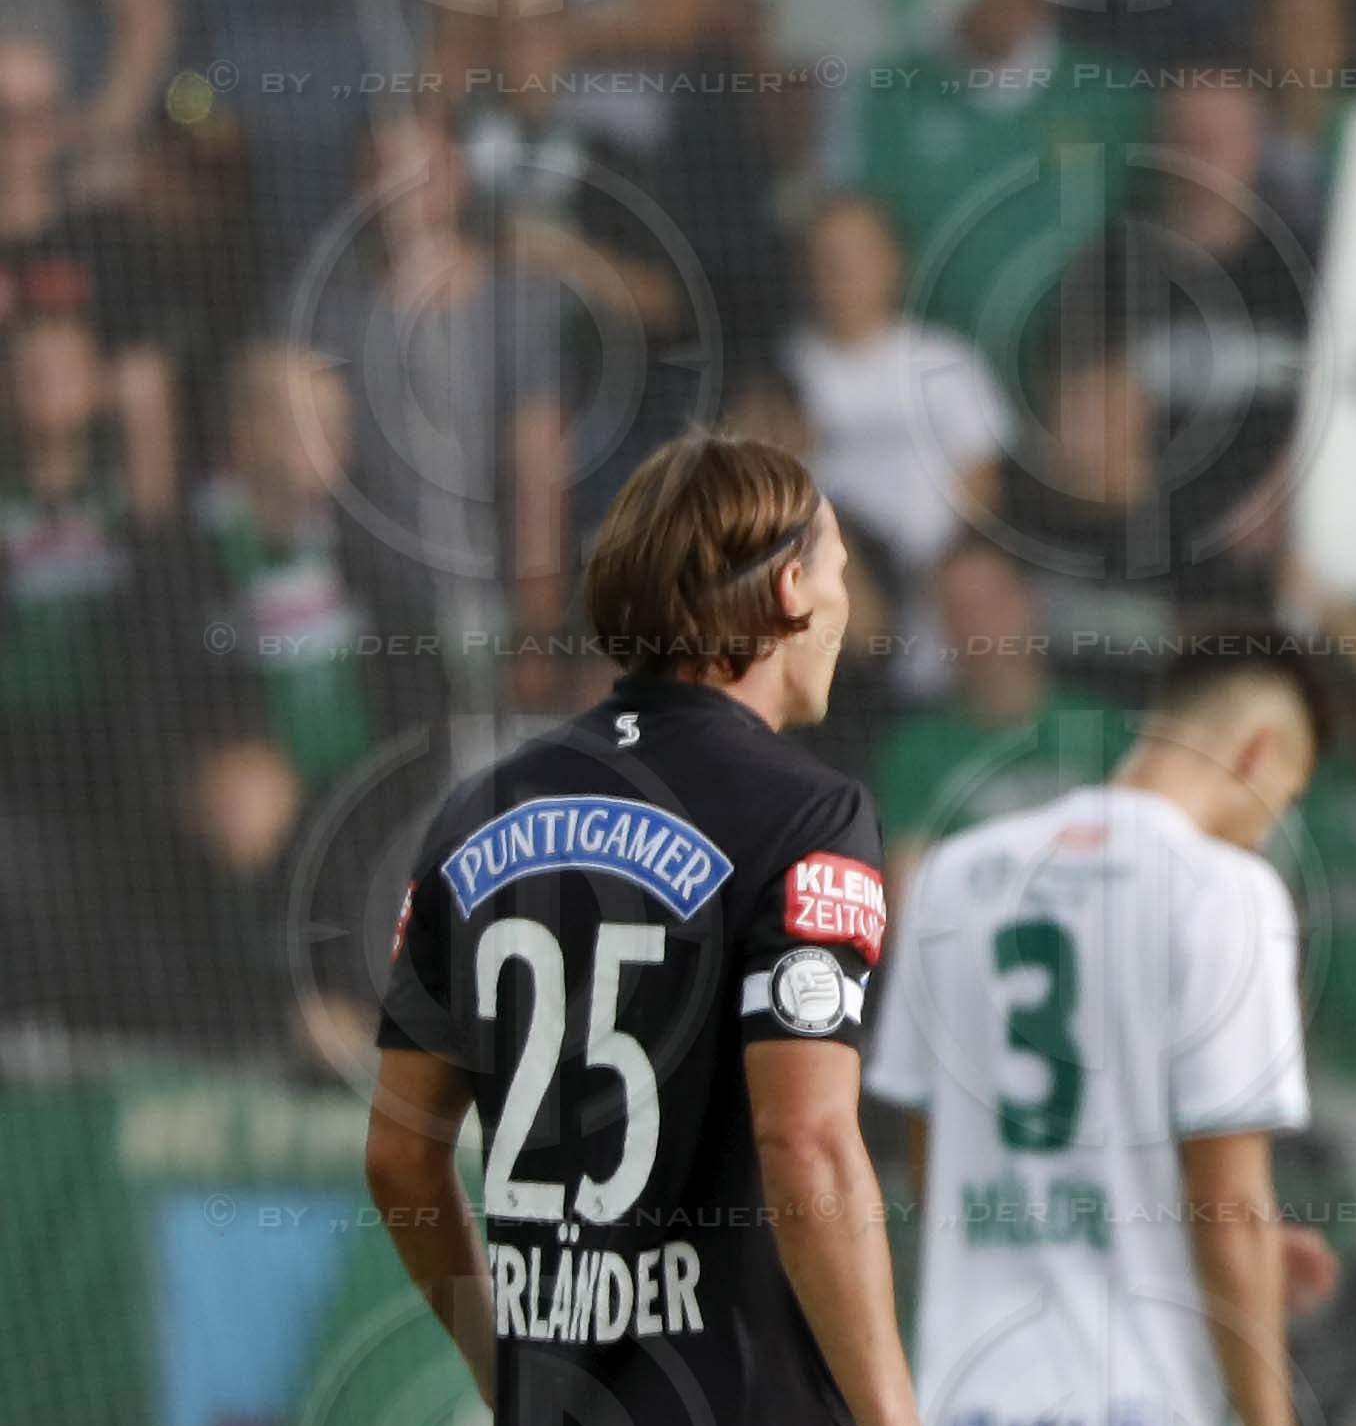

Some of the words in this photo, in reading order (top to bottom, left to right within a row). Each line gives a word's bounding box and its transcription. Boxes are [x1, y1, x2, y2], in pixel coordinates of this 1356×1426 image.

[458, 808, 712, 902] PUNTIGAMER
[475, 917, 666, 1224] 25
[992, 918, 1086, 1153] 3
